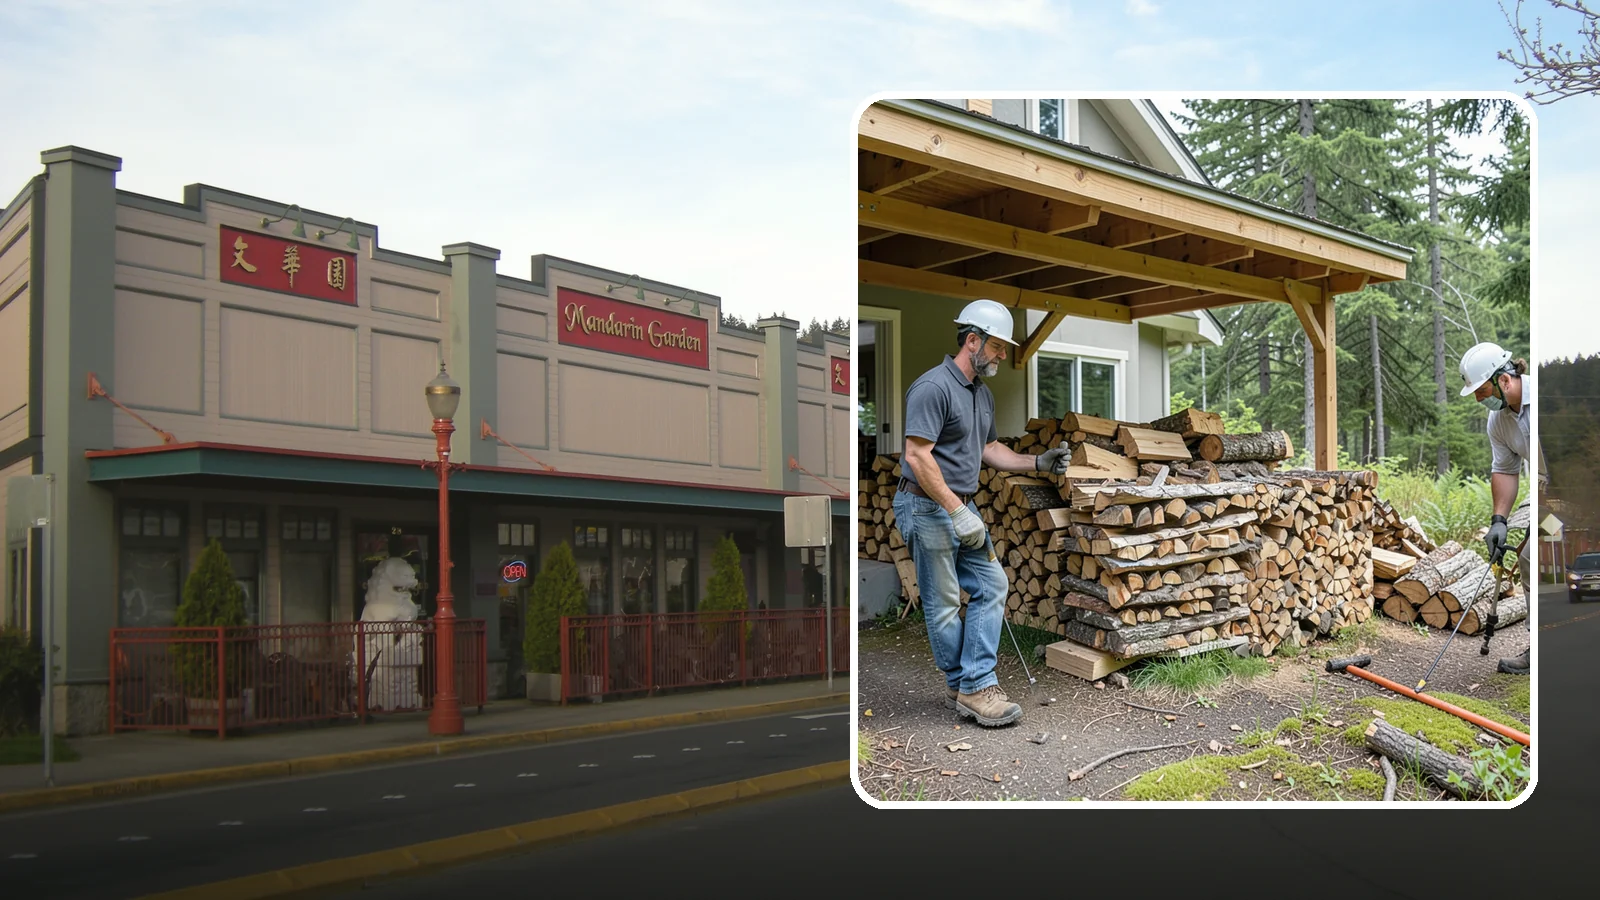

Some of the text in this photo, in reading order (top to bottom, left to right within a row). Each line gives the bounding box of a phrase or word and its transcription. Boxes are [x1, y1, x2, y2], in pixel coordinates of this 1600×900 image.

[231, 236, 346, 291] 文華園
[564, 302, 701, 352] Mandarin Garden
[503, 565, 527, 578] OPEN
